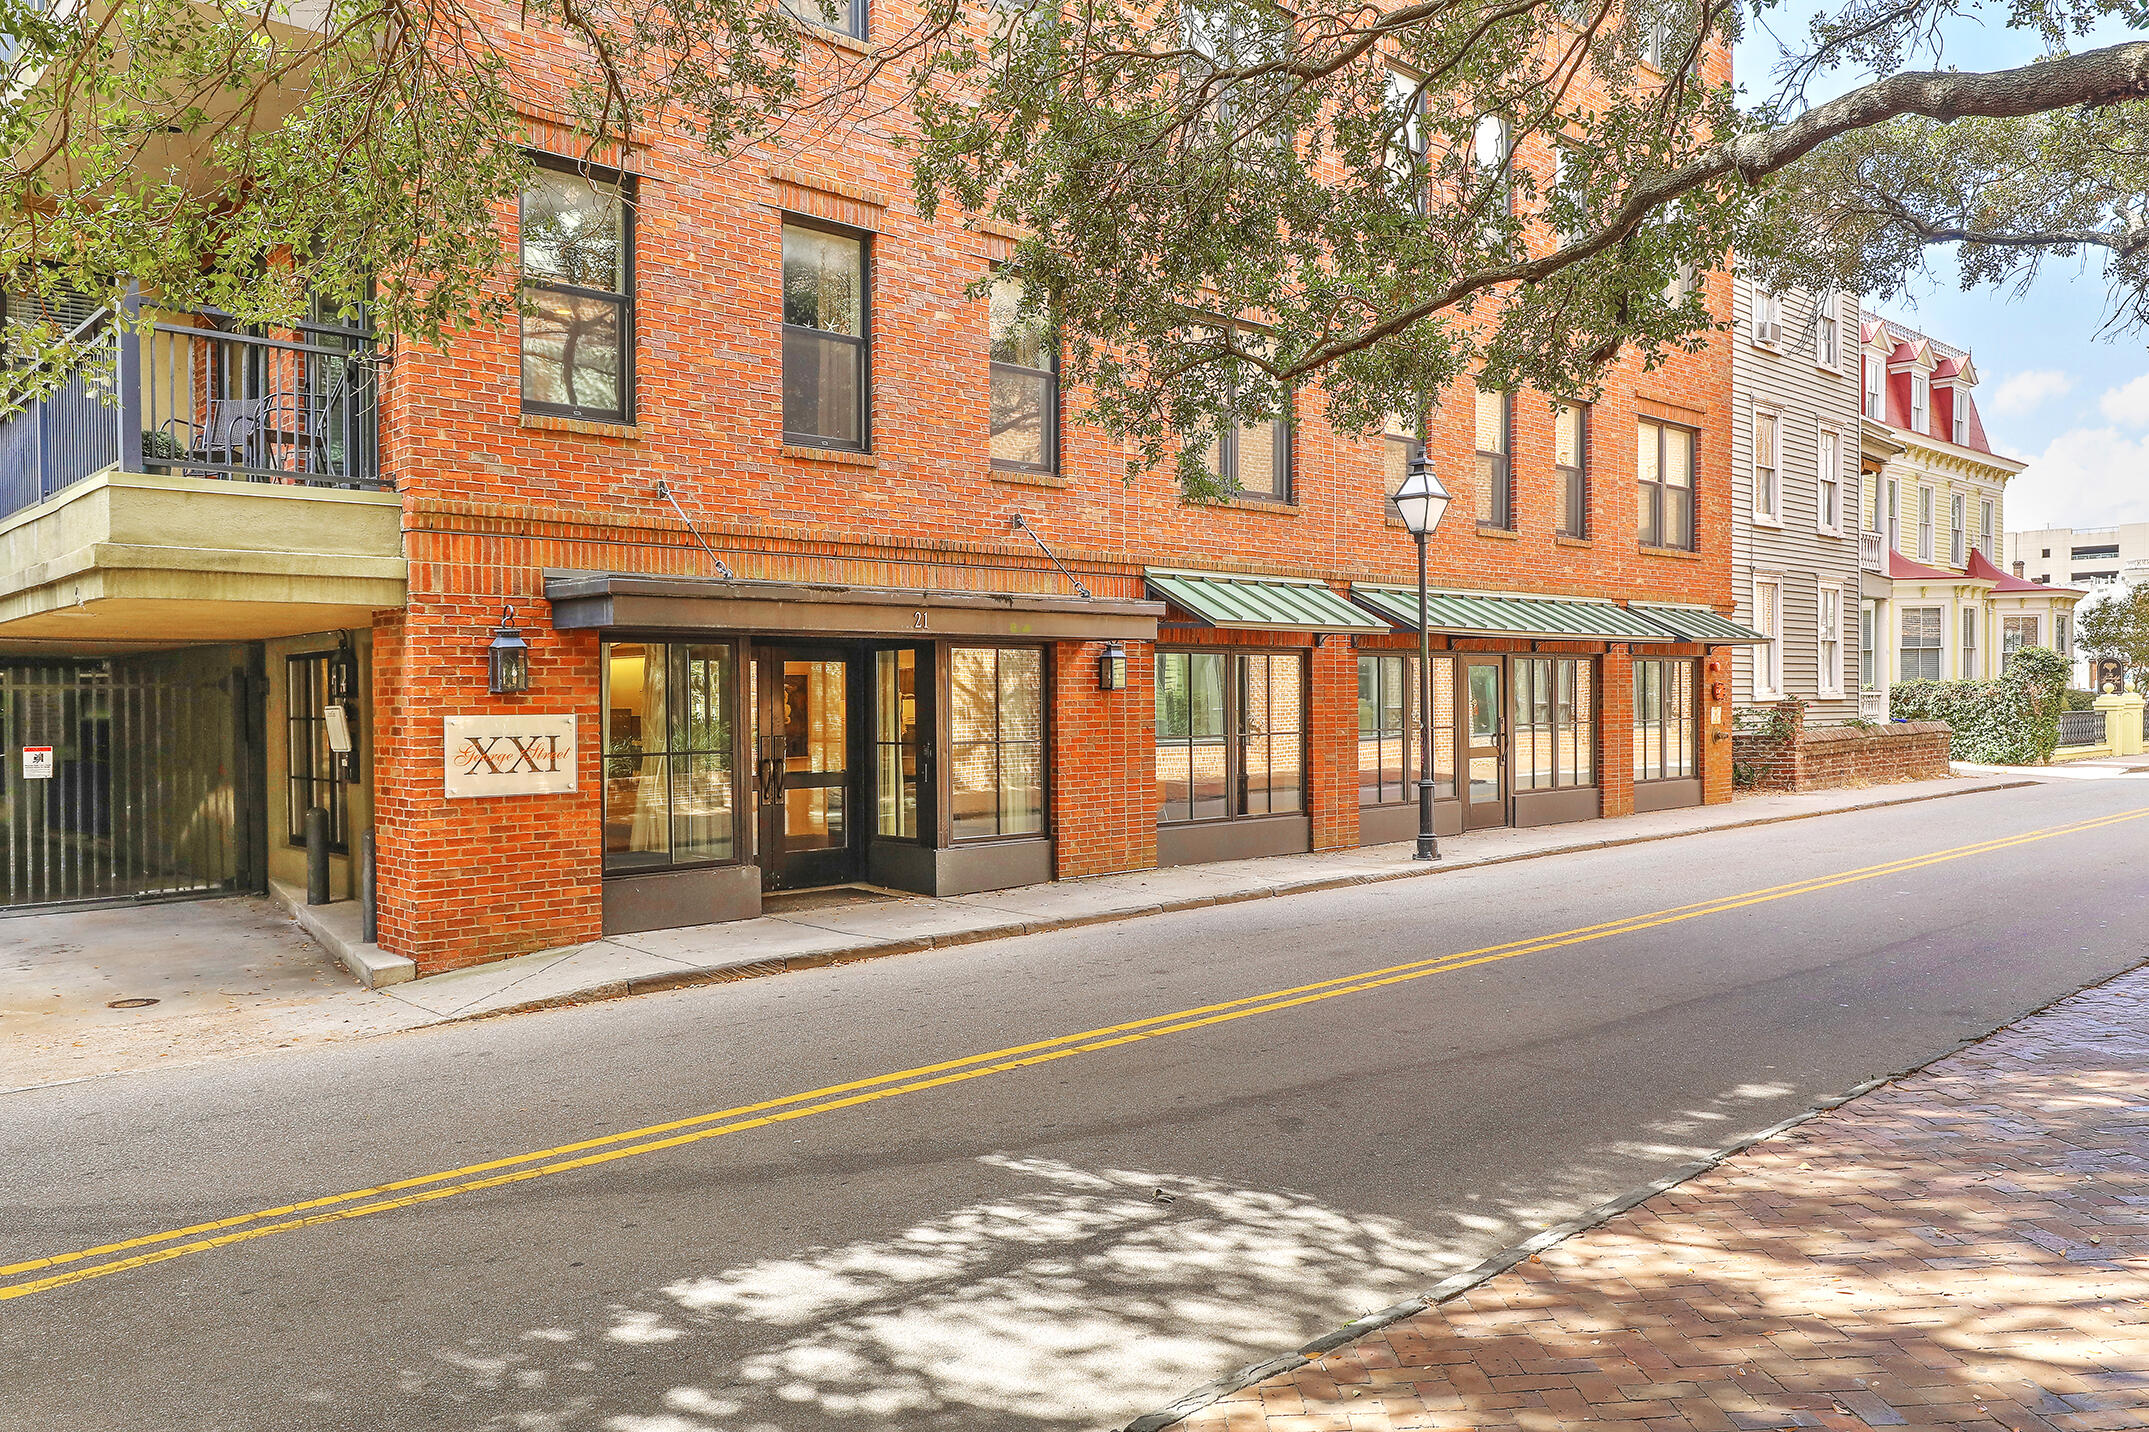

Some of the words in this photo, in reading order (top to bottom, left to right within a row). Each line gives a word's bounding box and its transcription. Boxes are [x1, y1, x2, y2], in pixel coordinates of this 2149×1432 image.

[914, 611, 929, 629] 21
[454, 742, 514, 767] George
[520, 742, 571, 761] Street
[463, 735, 561, 775] XXI
